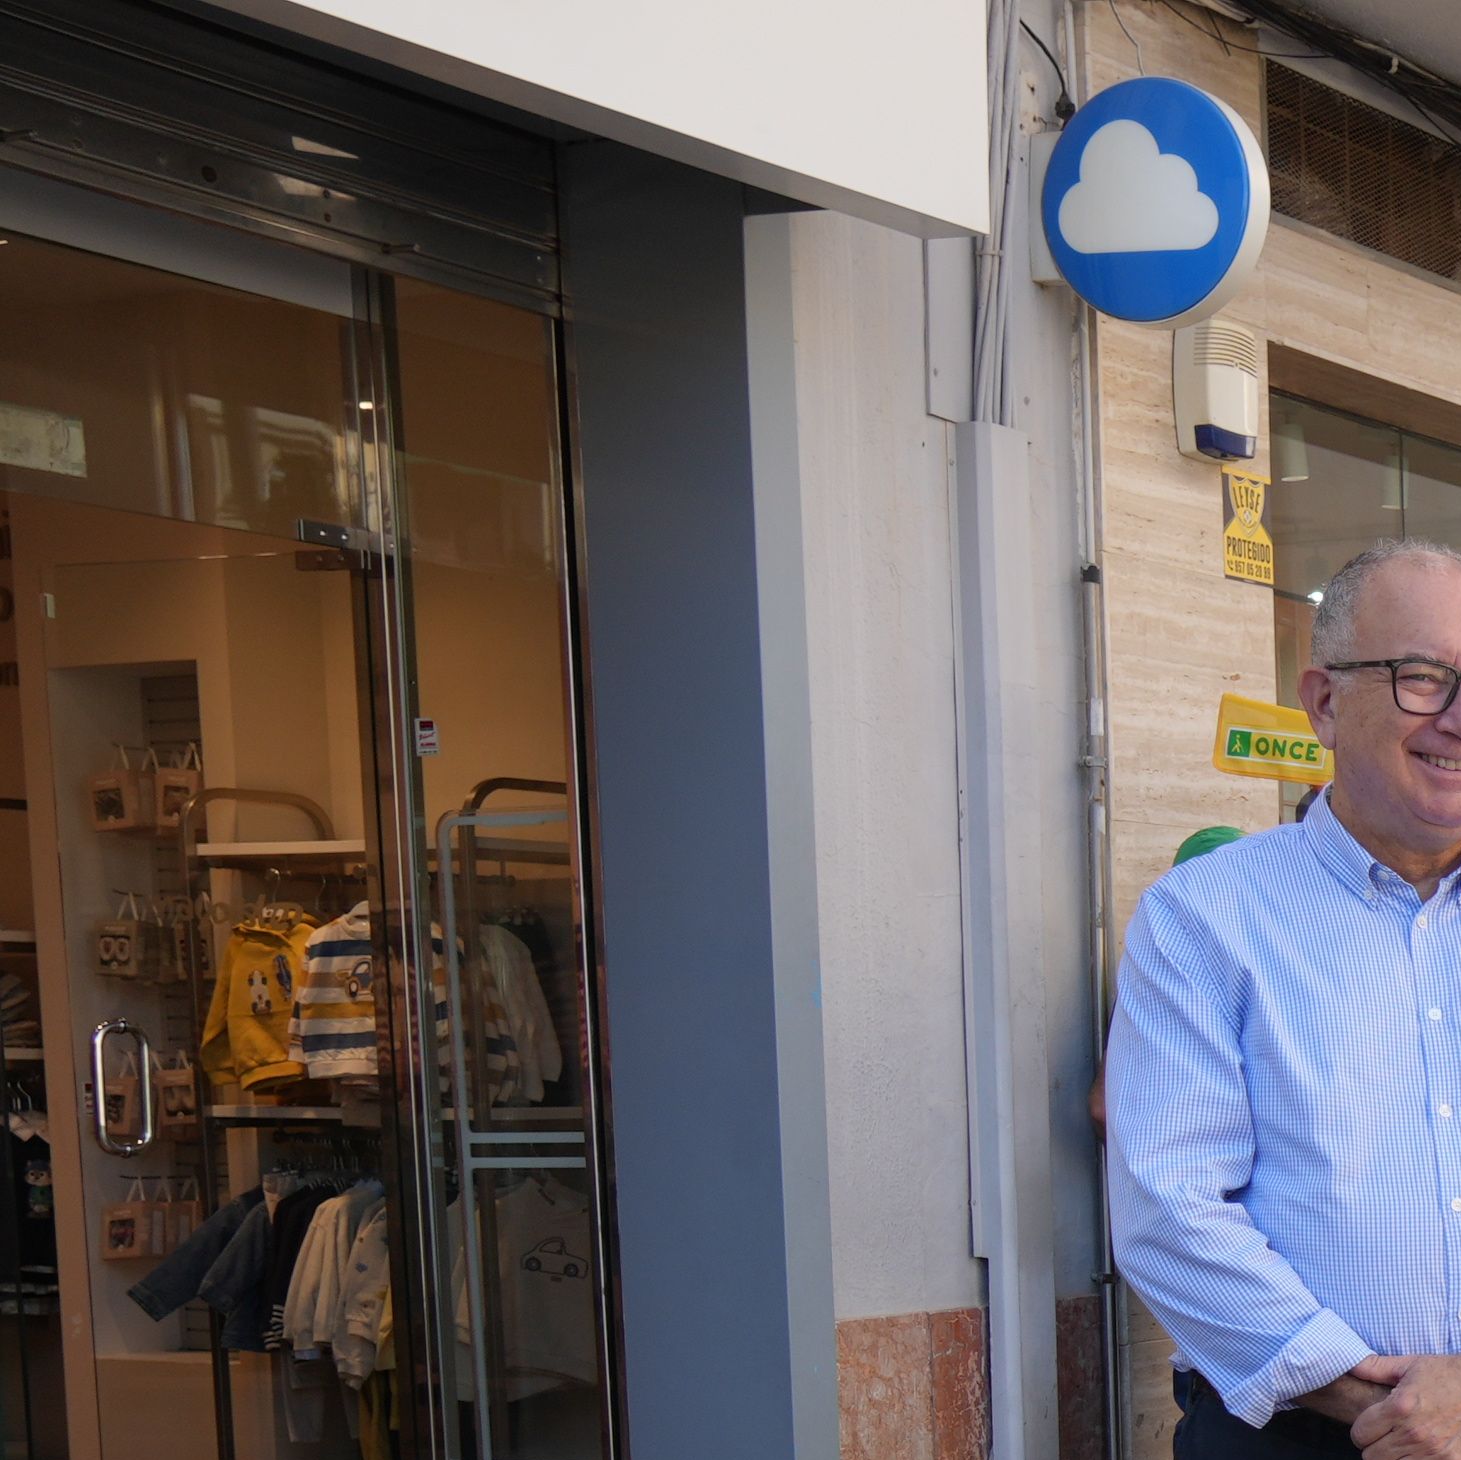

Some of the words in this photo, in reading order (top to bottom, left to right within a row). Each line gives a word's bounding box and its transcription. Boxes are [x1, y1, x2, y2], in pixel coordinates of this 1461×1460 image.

[1233, 486, 1260, 513] LEYSE
[1226, 536, 1271, 564] PROTEGIDO
[1255, 737, 1320, 762] ONCE
